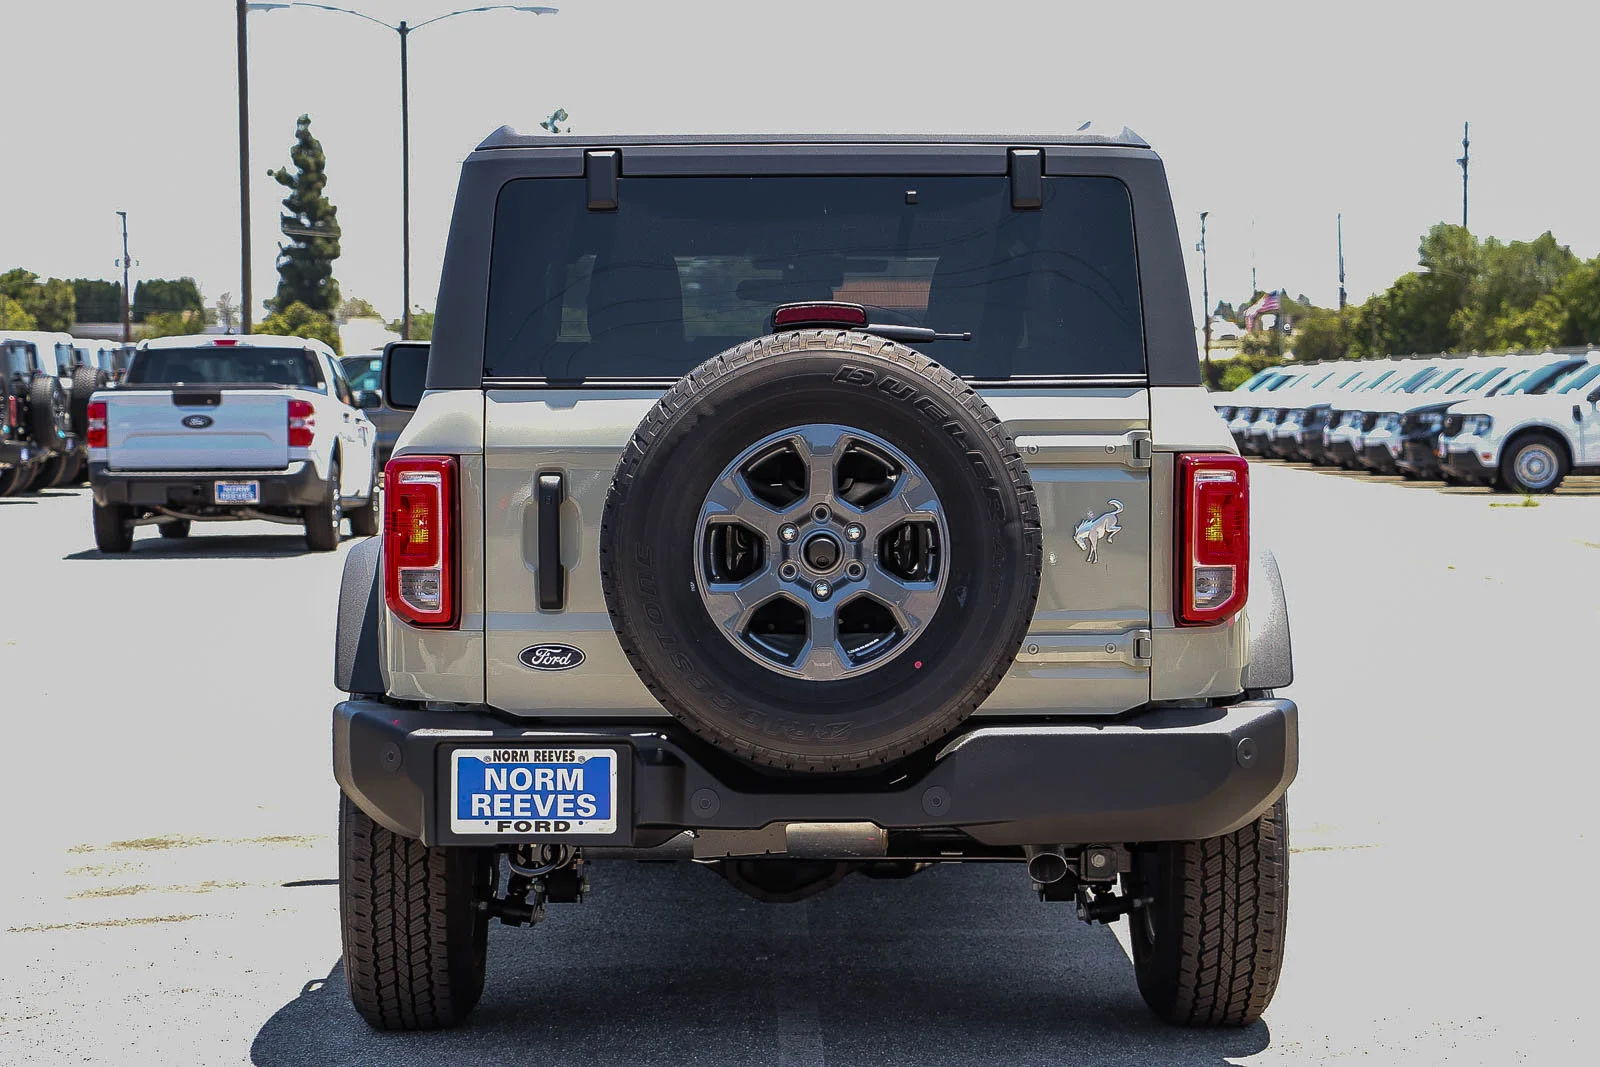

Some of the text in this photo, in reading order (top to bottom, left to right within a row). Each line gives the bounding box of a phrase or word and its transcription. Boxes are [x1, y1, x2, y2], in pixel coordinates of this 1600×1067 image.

[531, 648, 572, 665] Ford
[493, 750, 576, 763] NORM REEVES
[484, 767, 584, 791] NORM
[471, 793, 597, 818] REEVES
[497, 820, 571, 833] FORD
